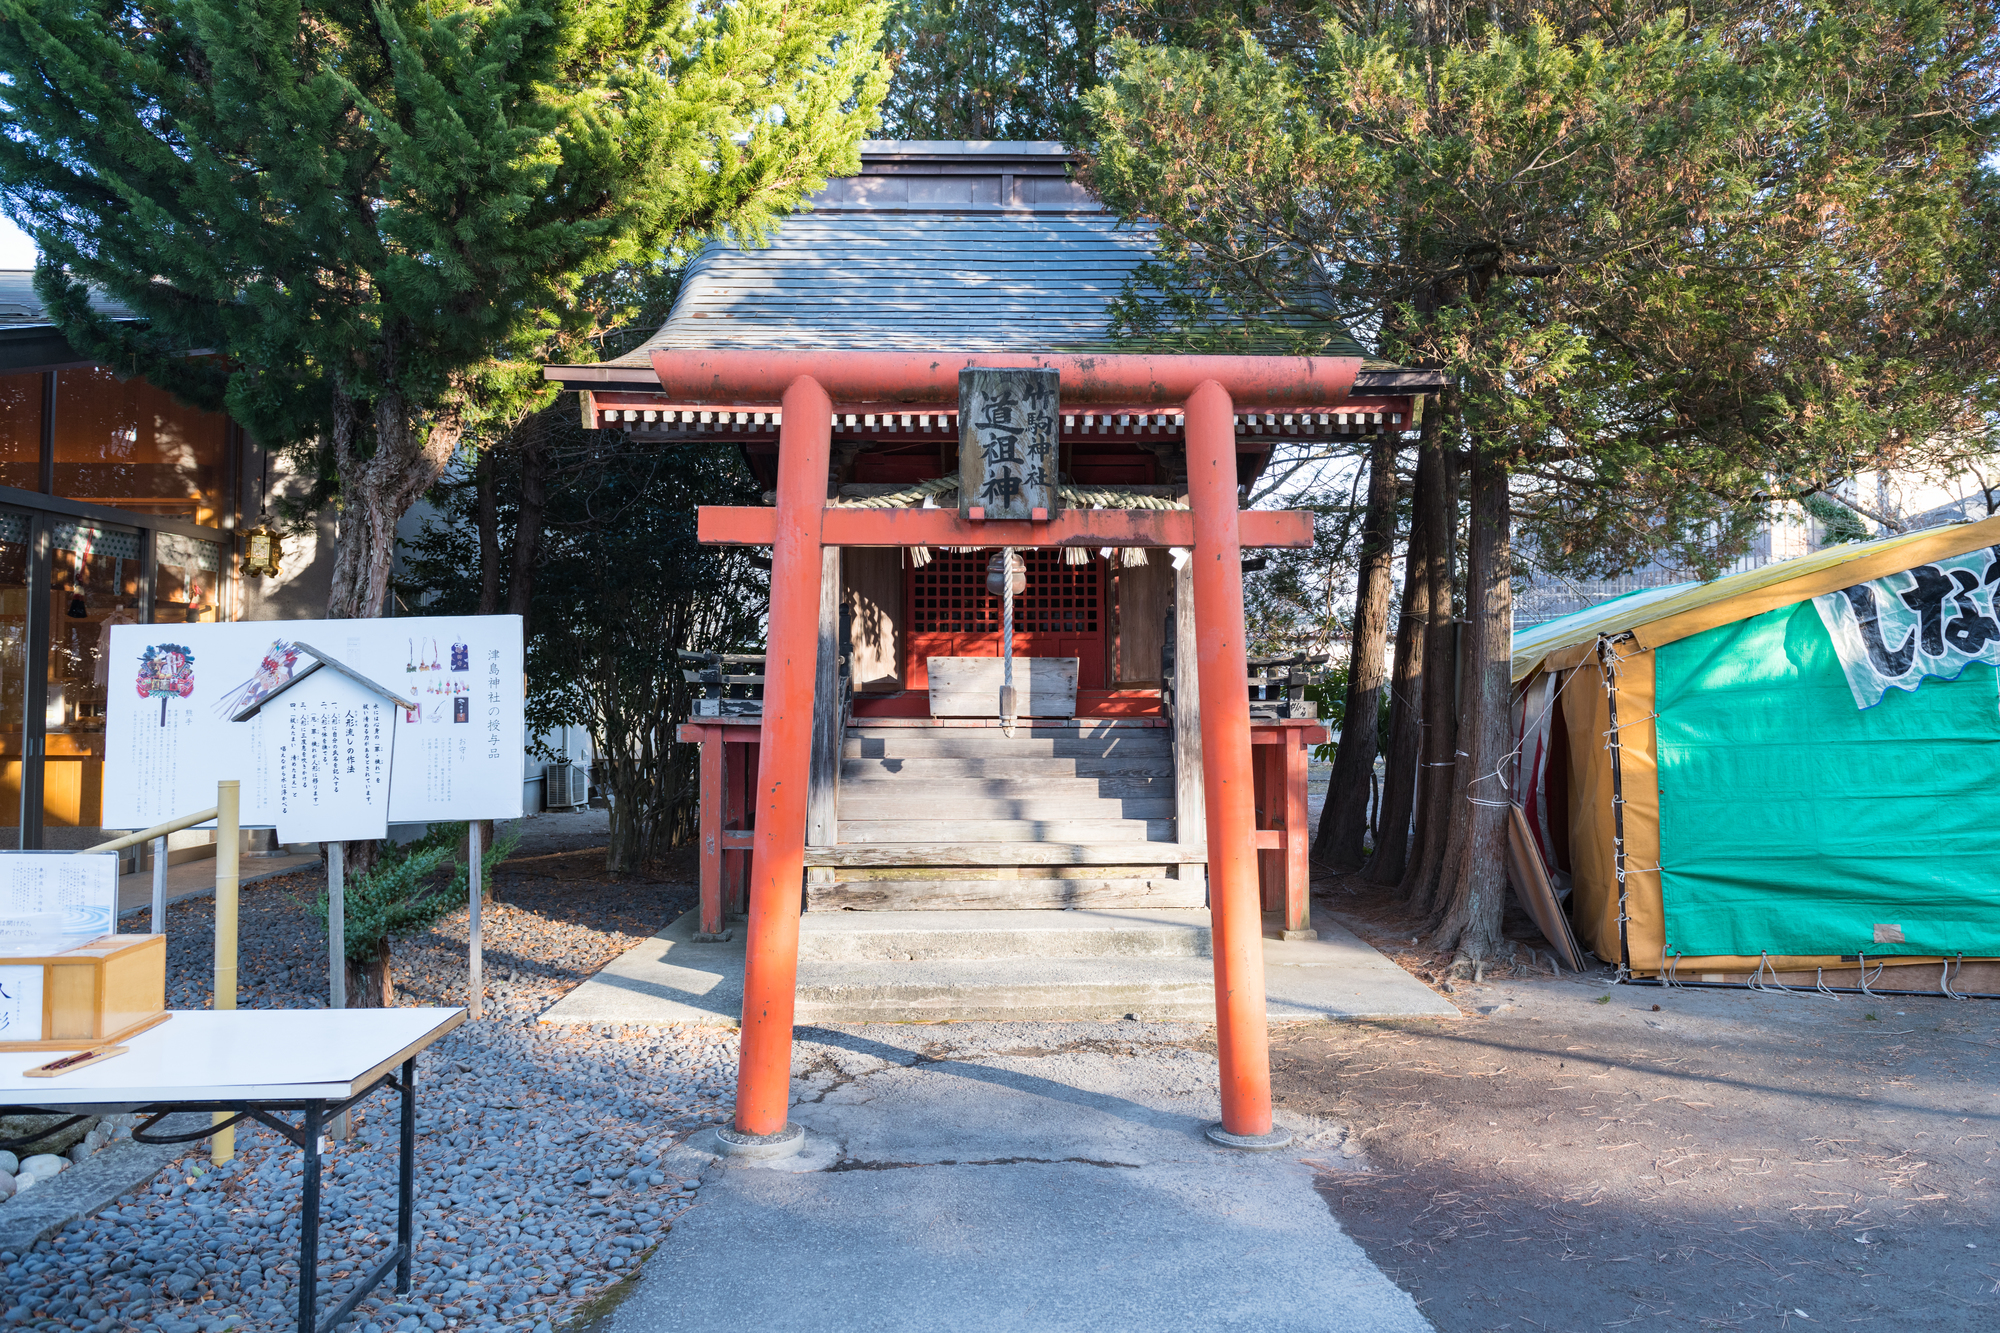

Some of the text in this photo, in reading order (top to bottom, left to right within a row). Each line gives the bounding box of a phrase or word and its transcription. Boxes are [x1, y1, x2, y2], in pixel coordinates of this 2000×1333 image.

[974, 390, 1025, 509] 道祖神
[1021, 382, 1055, 490] 竹駒神社
[345, 709, 356, 774] 人形流しの作法
[458, 737, 467, 763] お守り
[487, 649, 501, 759] 津島神社の授与品
